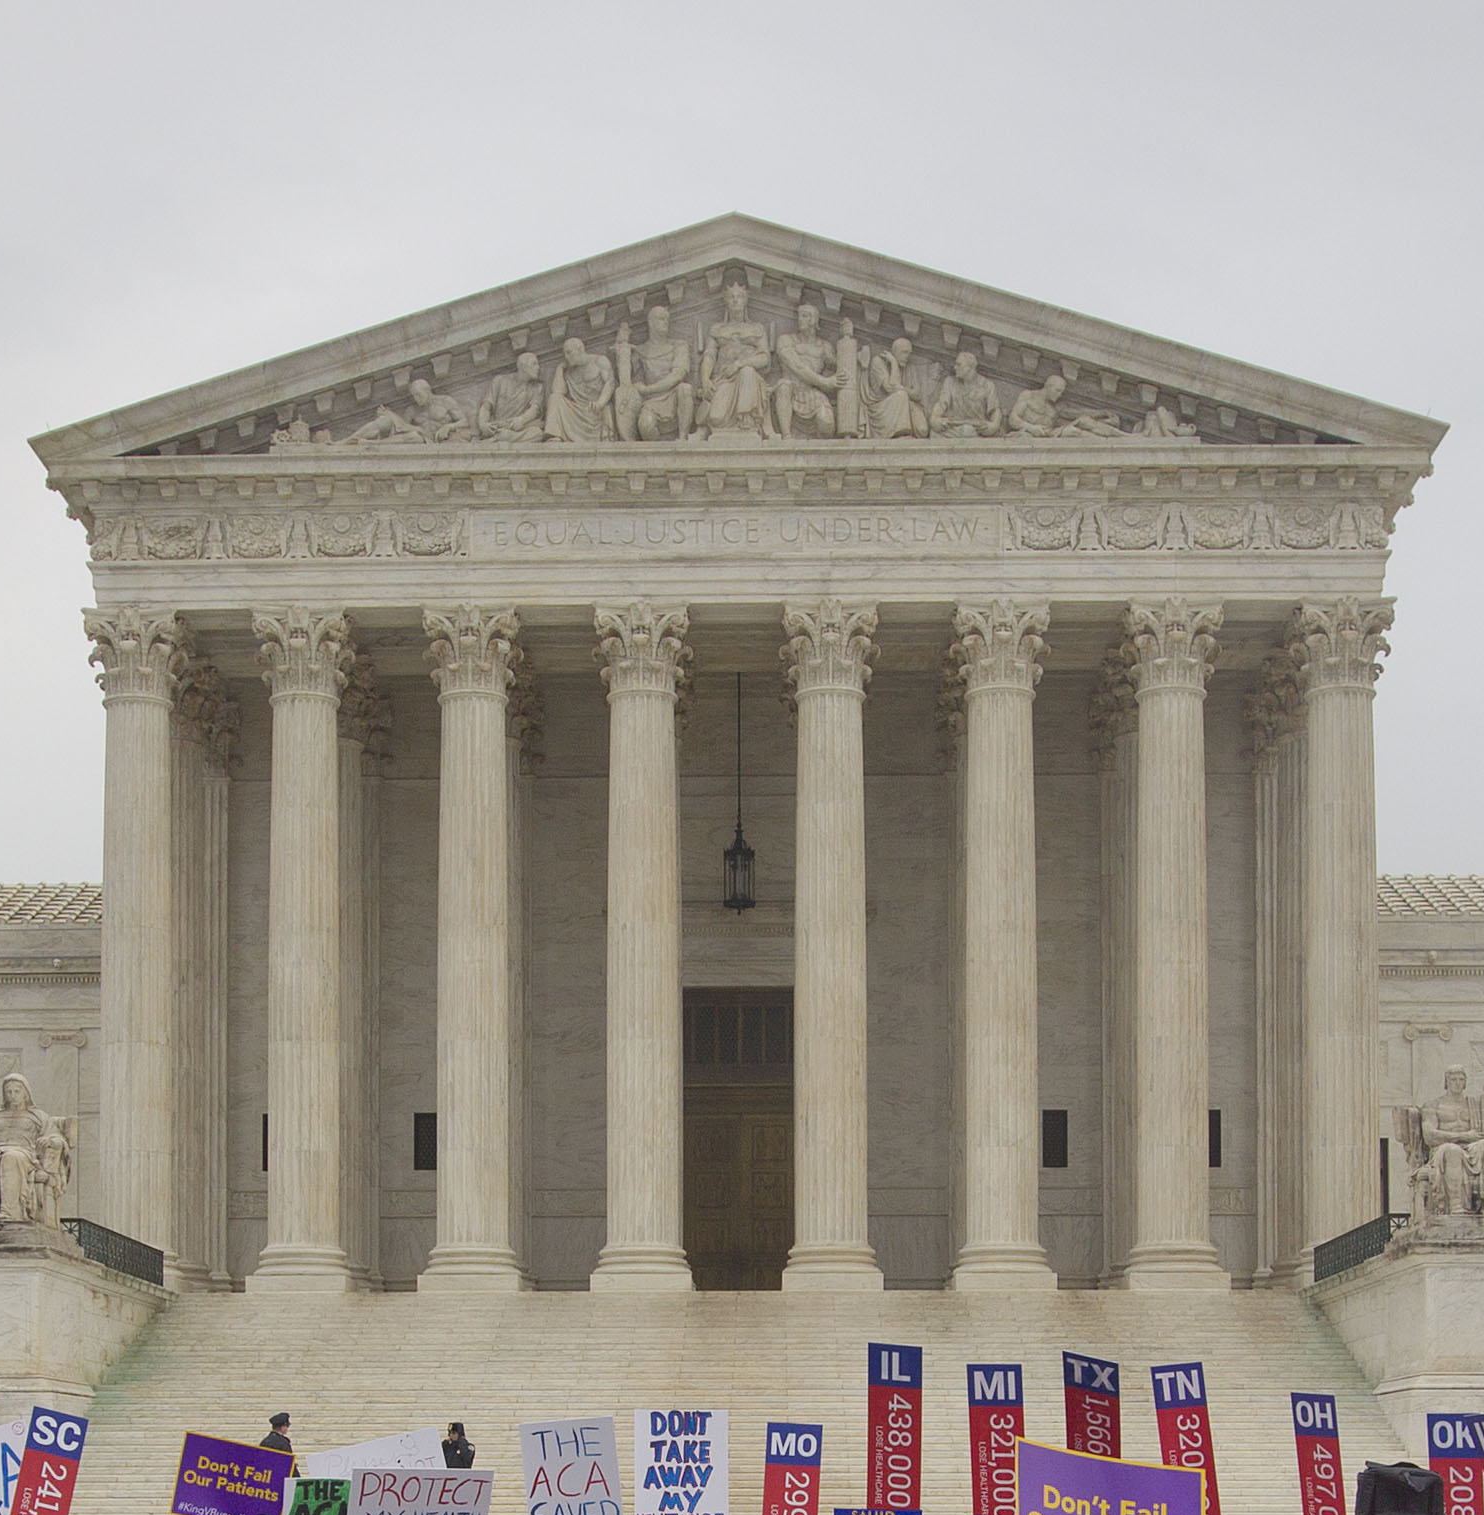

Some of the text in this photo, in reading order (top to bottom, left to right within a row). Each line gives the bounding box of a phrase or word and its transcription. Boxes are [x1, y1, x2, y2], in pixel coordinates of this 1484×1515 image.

[495, 515, 982, 548] EQUAL JUSTICE UNDER LAW
[881, 1351, 911, 1382] IL
[1066, 1357, 1116, 1392] TX
[973, 1370, 1016, 1400] MI
[1155, 1369, 1202, 1402] TN
[650, 1410, 712, 1437] DONT
[1296, 1401, 1333, 1429] OH
[32, 1415, 82, 1451] SC
[532, 1427, 602, 1461] THE
[770, 1432, 817, 1457] MO
[1433, 1421, 1471, 1449] OK
[650, 1440, 711, 1464] TAKE
[874, 1425, 883, 1505] LOSE HEALTHCARE
[885, 1393, 913, 1508] 438,000
[978, 1441, 987, 1463] LOSE
[198, 1456, 272, 1483] Don't Fail
[530, 1461, 610, 1499] ACA
[643, 1465, 713, 1489] AWAY
[20, 1488, 33, 1510] LOSE
[183, 1470, 279, 1503] Our Patients
[295, 1481, 345, 1501] THE
[359, 1472, 491, 1507] PROTECT
[1305, 1477, 1314, 1498] LOSE
[658, 1490, 704, 1513] MY
